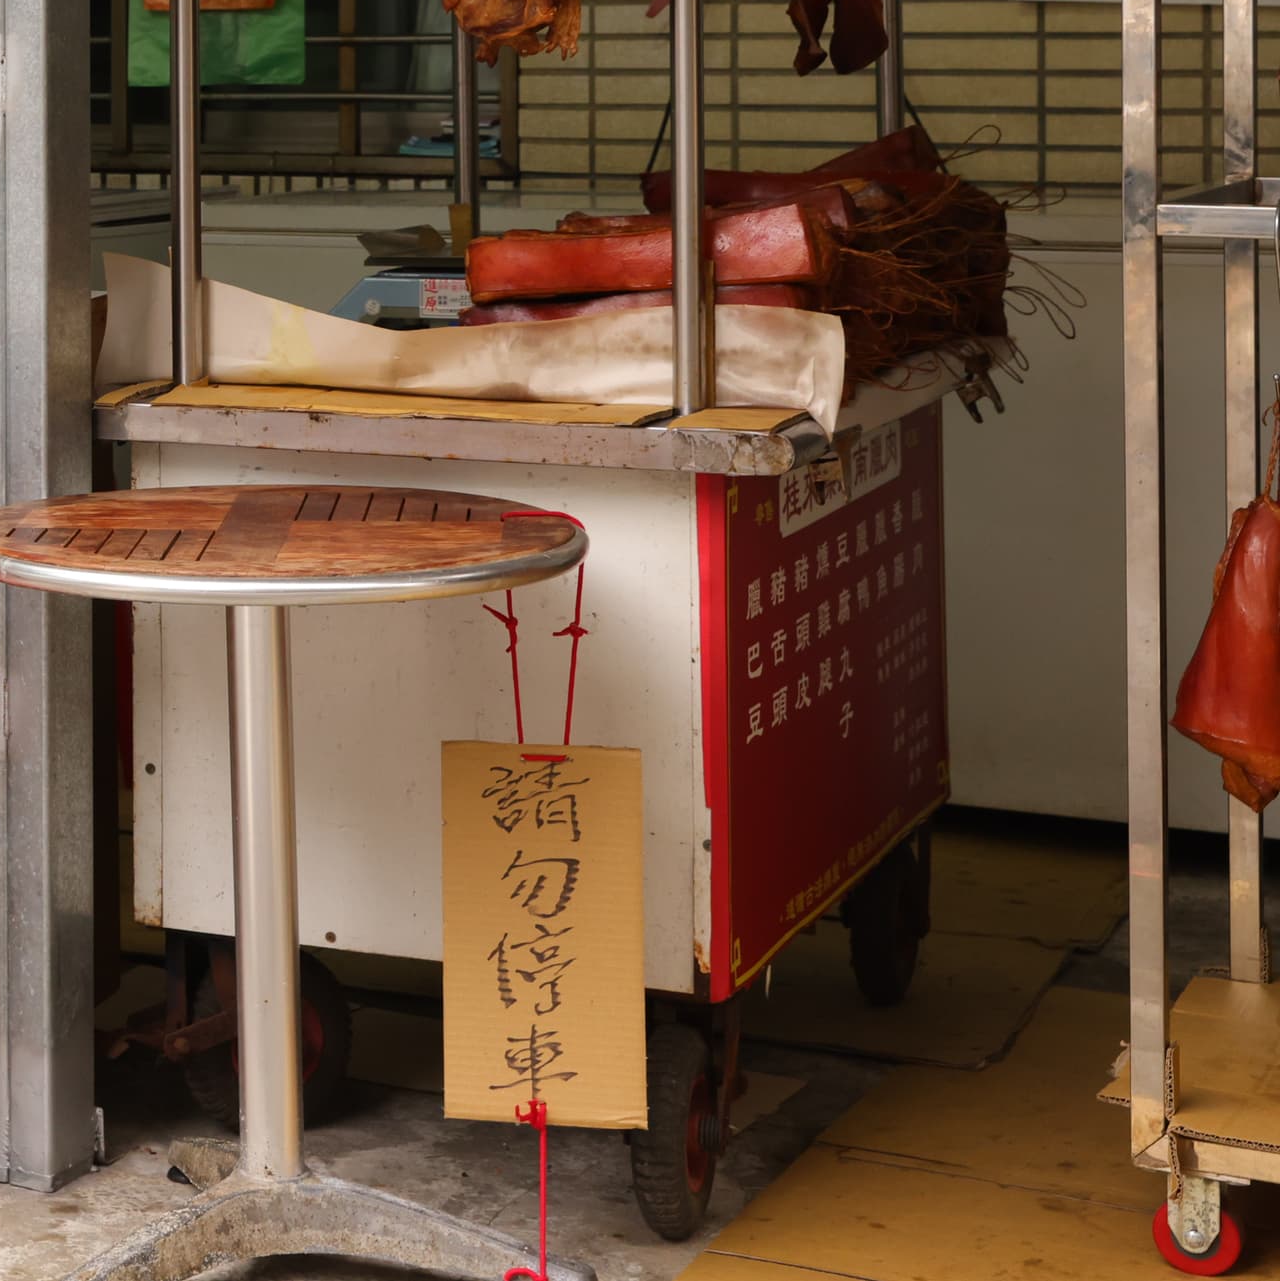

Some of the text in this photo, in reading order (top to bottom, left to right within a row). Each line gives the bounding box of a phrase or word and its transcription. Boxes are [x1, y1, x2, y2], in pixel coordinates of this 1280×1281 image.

[746, 578, 764, 745] 臘巴豆
[770, 565, 788, 728] 豬舌頭
[793, 554, 812, 710] 豬頭皮
[482, 759, 591, 1100] 請勿停車
